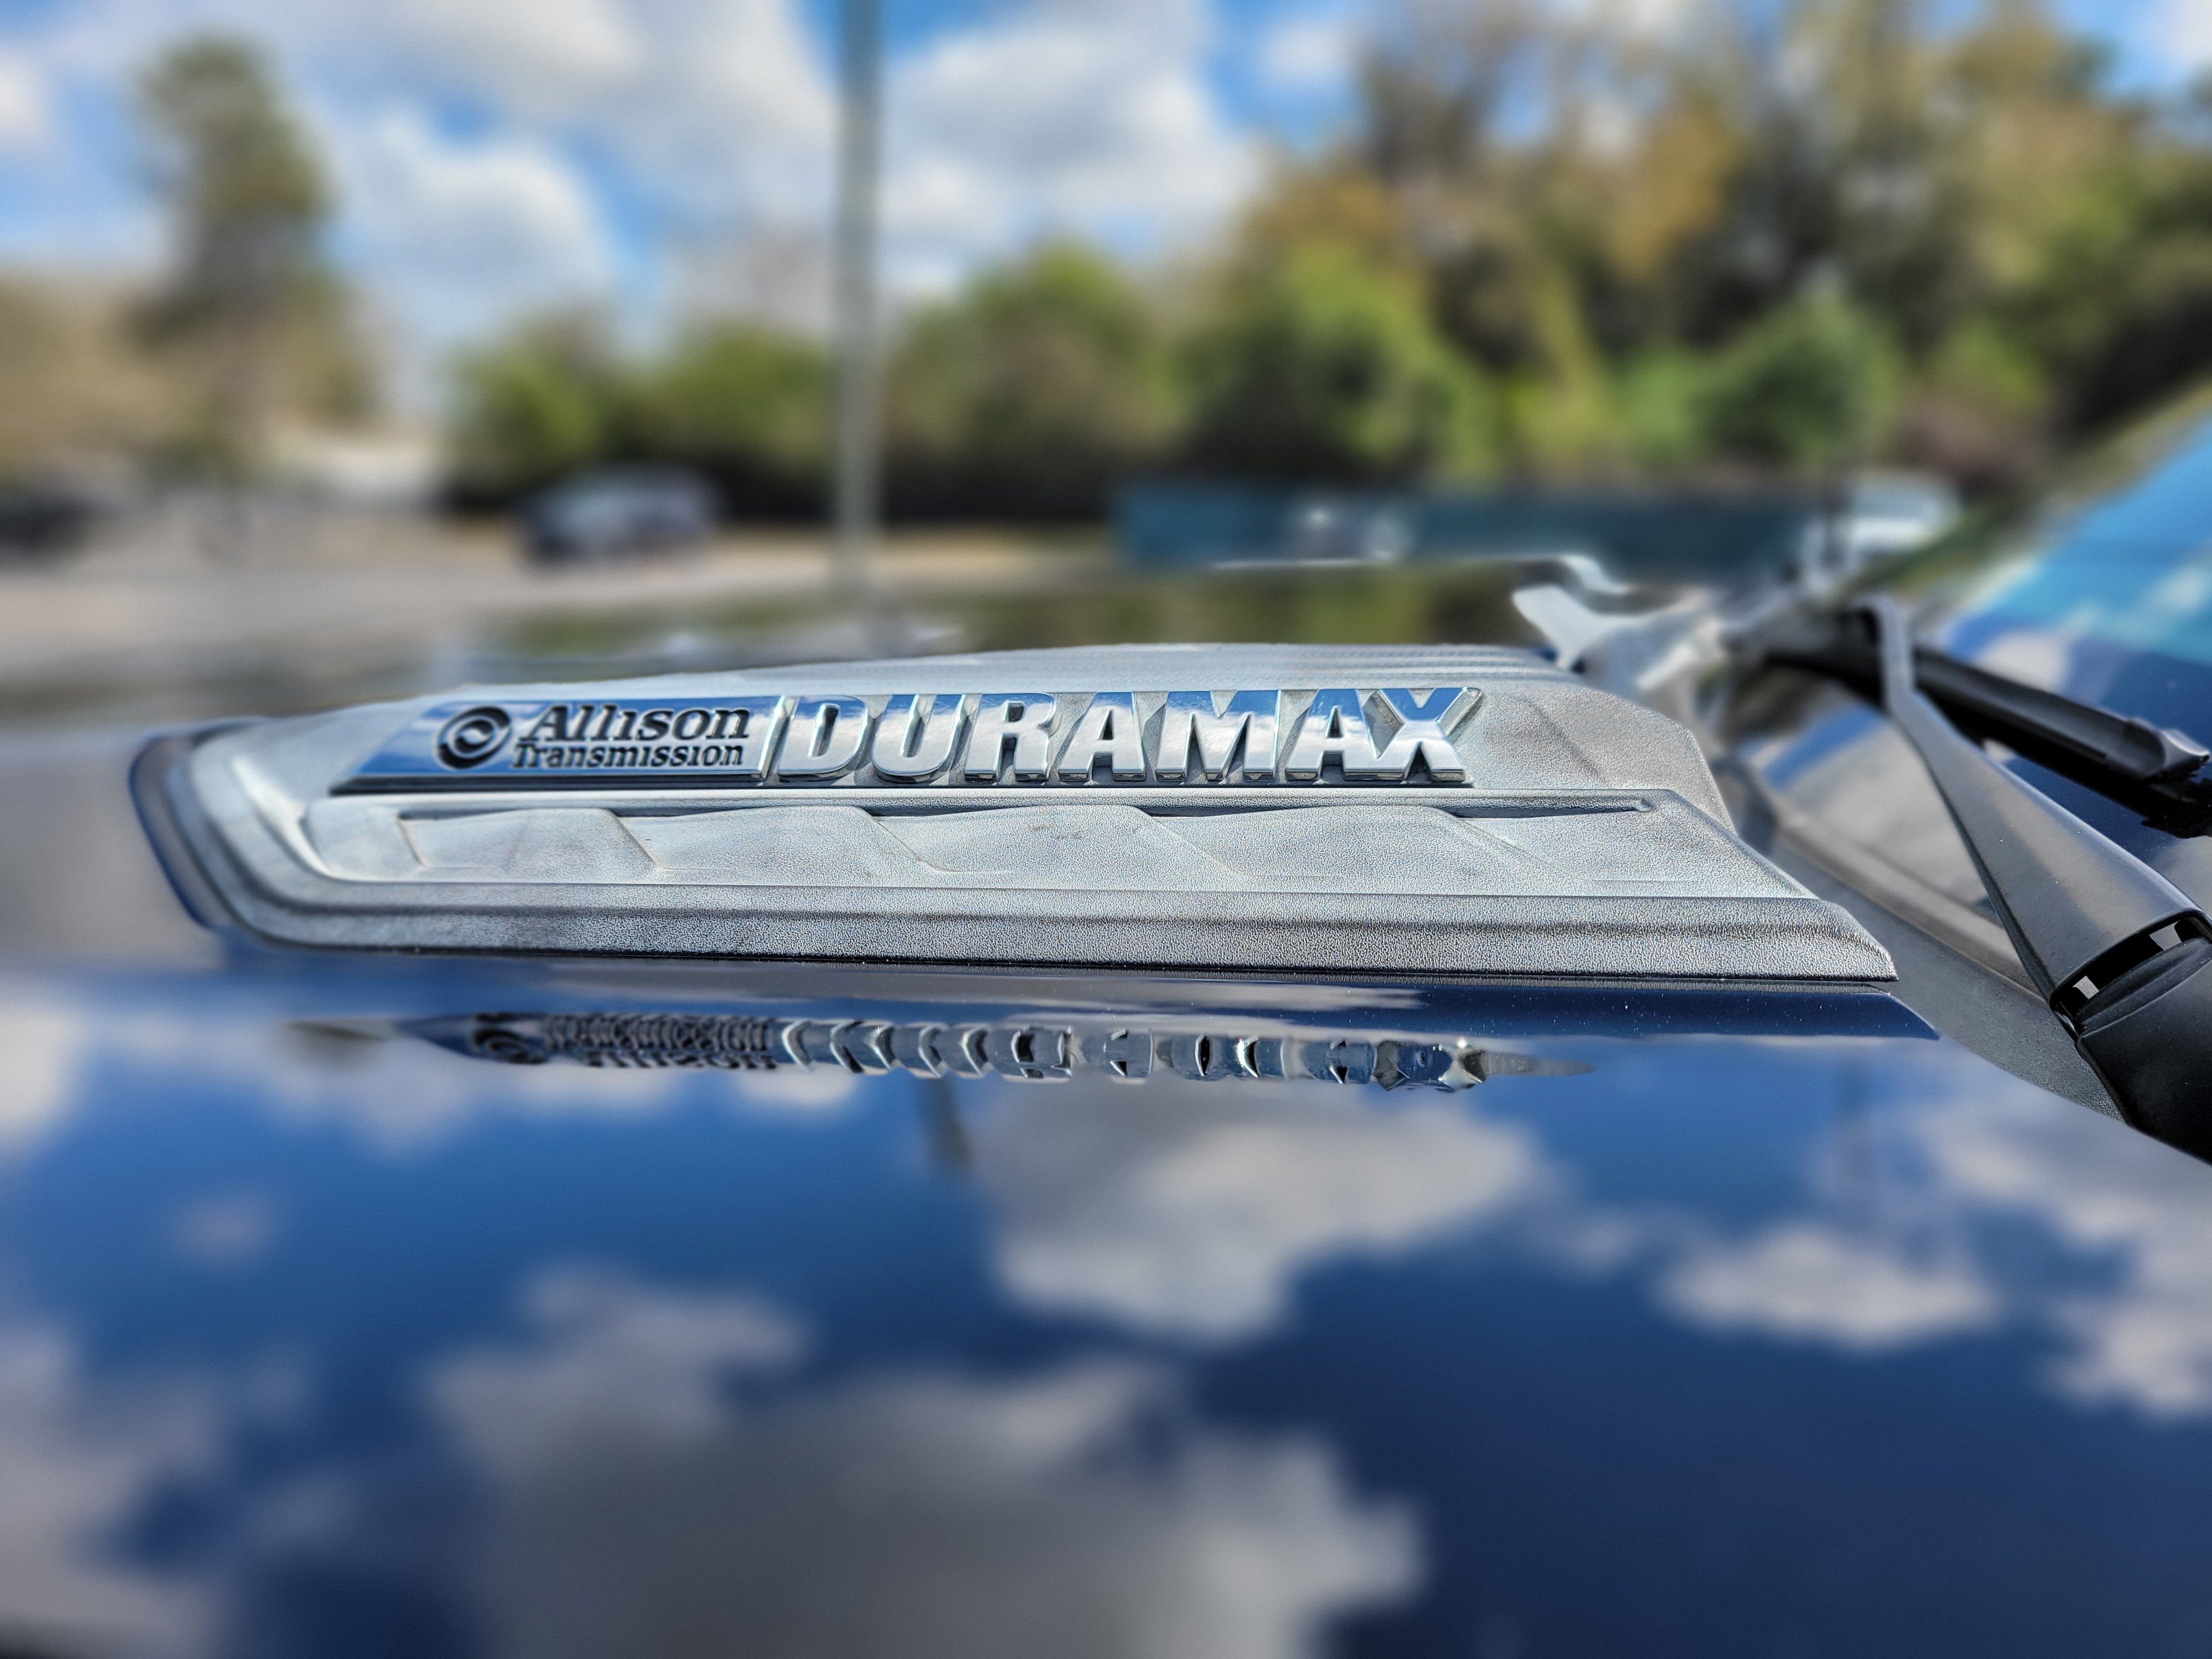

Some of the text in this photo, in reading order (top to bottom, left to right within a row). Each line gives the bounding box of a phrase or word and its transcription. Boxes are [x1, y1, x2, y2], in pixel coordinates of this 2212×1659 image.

[519, 704, 750, 741] Allison
[778, 687, 1481, 783] DURAMAX
[512, 742, 744, 768] Transmission
